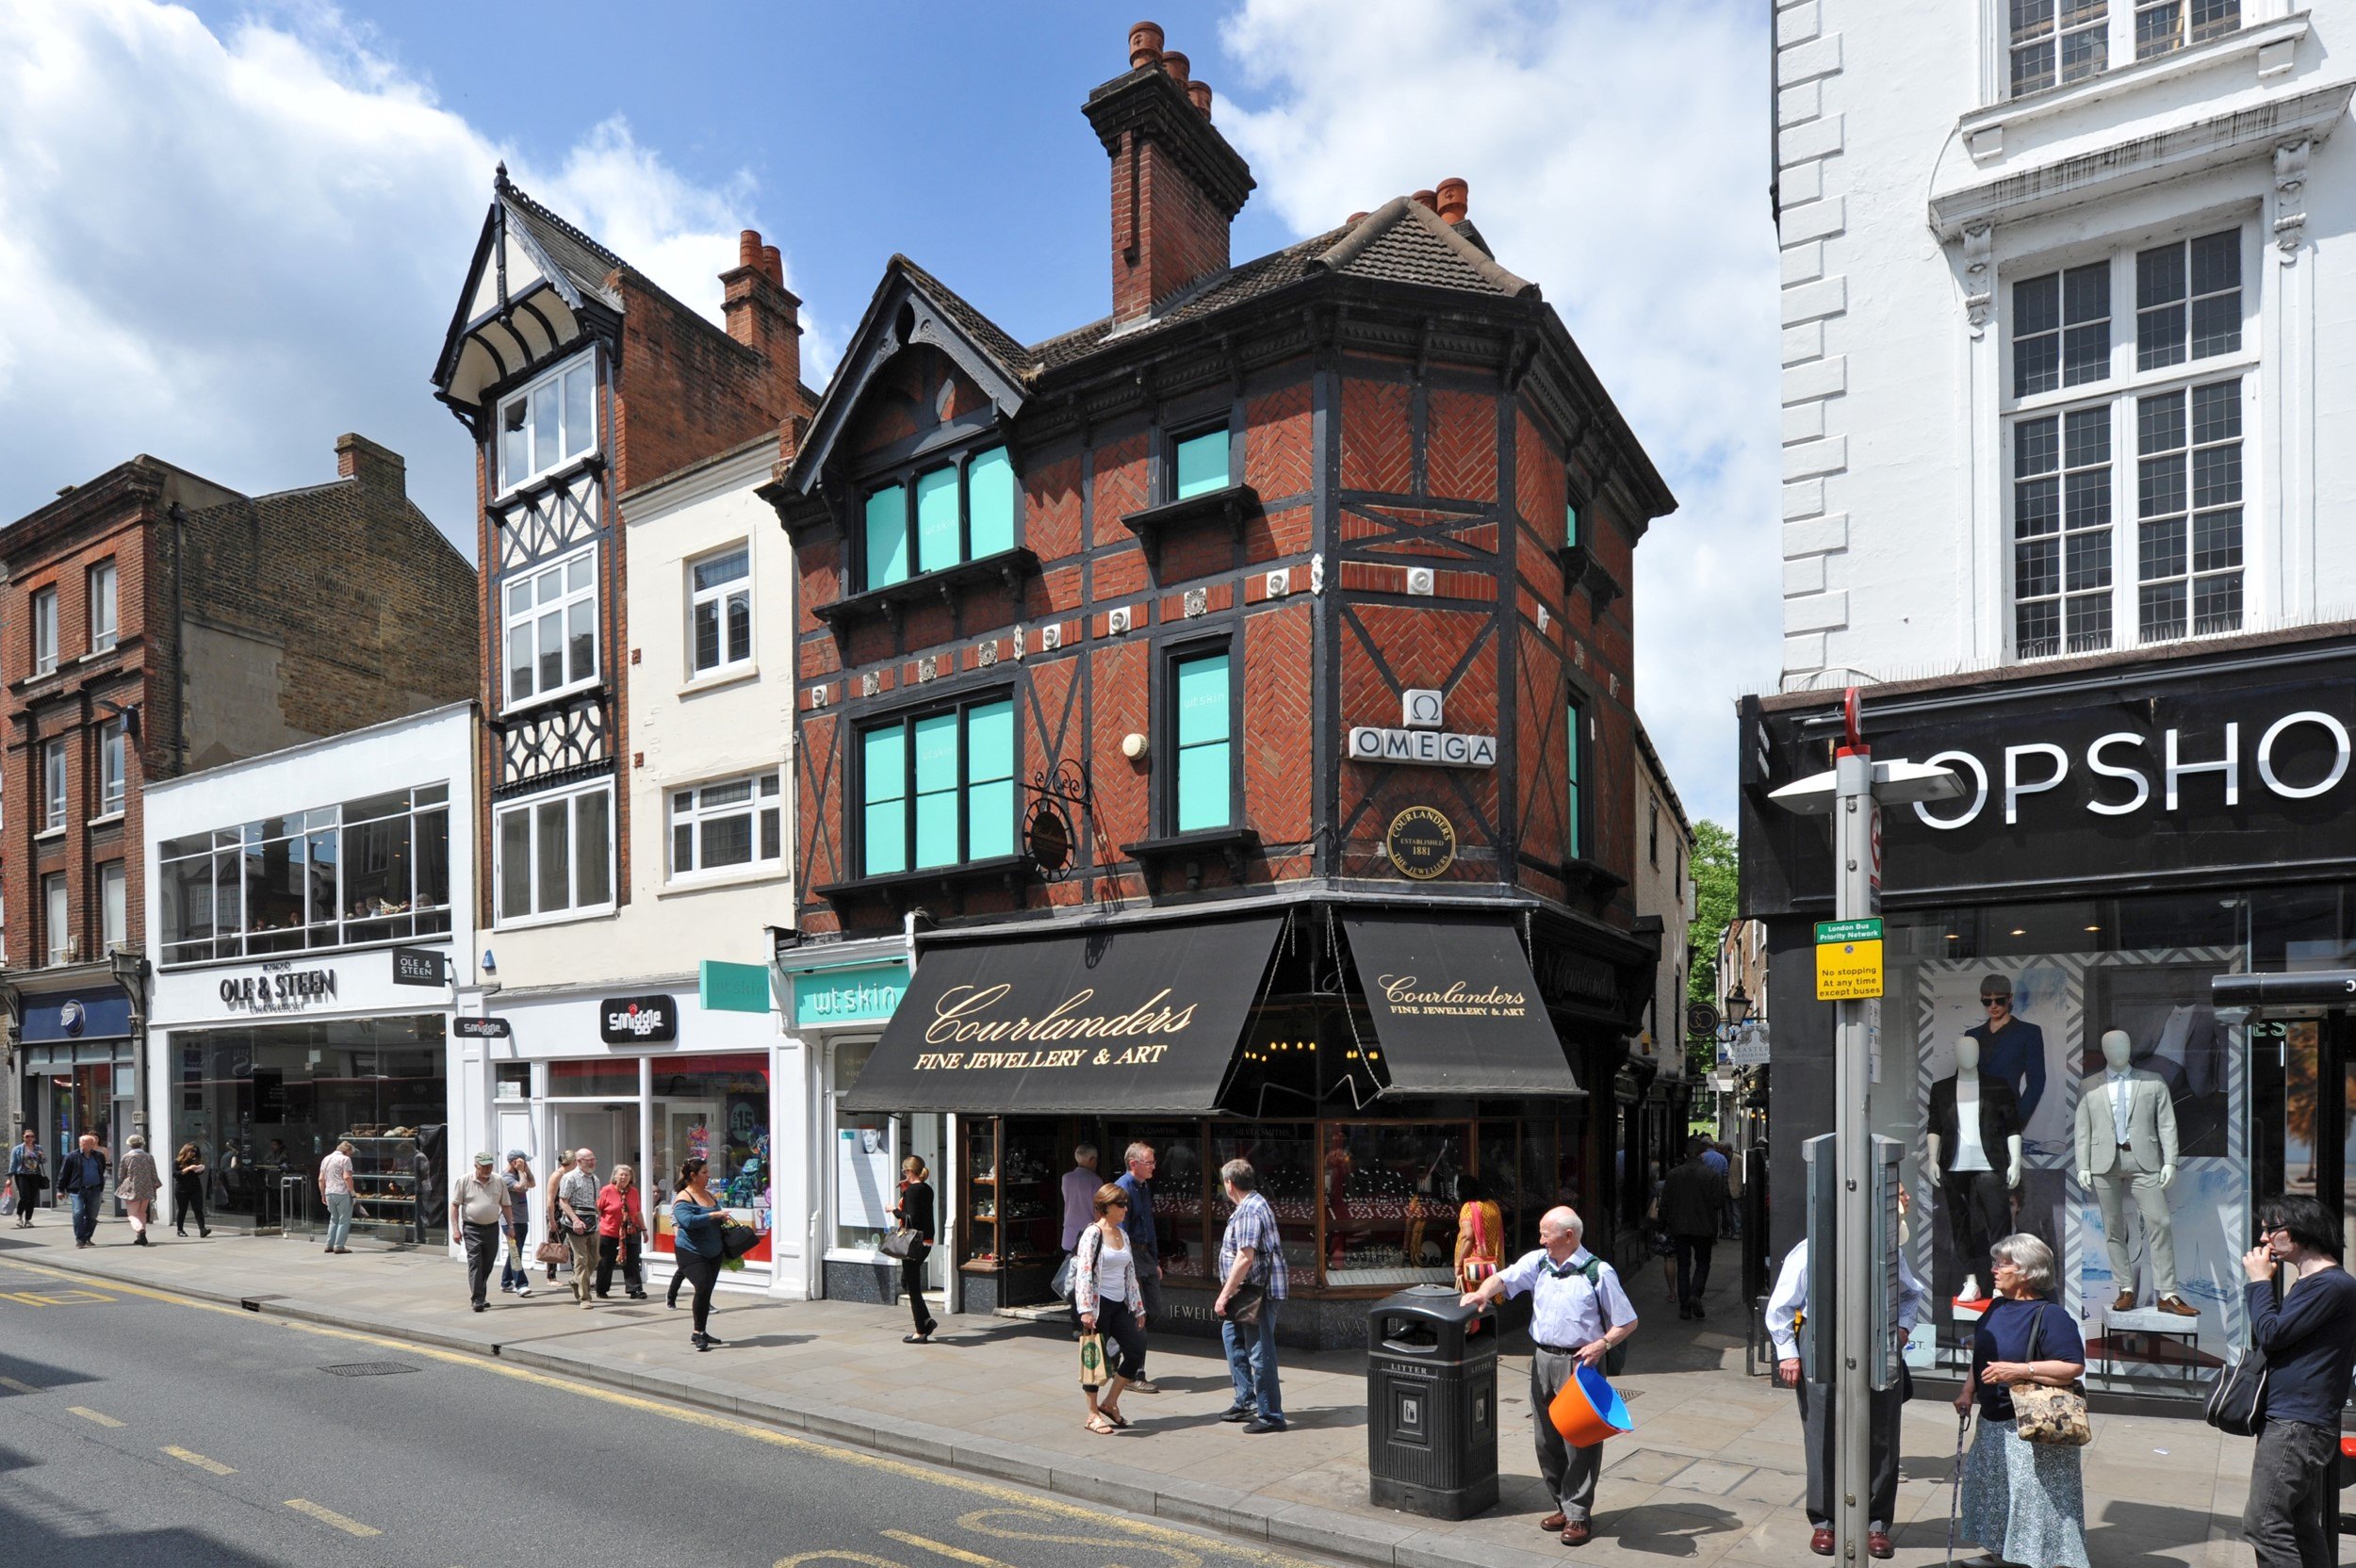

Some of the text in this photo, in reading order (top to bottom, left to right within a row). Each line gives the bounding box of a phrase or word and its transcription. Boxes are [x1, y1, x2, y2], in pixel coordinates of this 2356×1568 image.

[1358, 731, 1494, 762] OMEGA
[1871, 711, 2351, 829] OPSHO
[1393, 811, 1451, 841] COURLANDERS
[1400, 838, 1444, 846] ESTABLISHED
[1413, 846, 1431, 856] 1881
[1408, 855, 1448, 874] JEWELLERS
[1848, 930, 1879, 939] Network
[400, 957, 432, 969] OLE &
[401, 966, 433, 976] STEEN
[1838, 967, 1877, 975] stopping
[220, 969, 335, 1003] OLE & STEEN
[1378, 973, 1526, 1004] Courlanders
[1820, 988, 1850, 997] except
[925, 983, 1198, 1044] Courlanders
[1390, 1005, 1526, 1016] FINE JEWELLERY & ART
[913, 1045, 1168, 1070] FINE JEWELLERY & ART
[1170, 1304, 1223, 1322] JEWELL
[1336, 1317, 1399, 1333] WATH
[1391, 1363, 1427, 1375] LITTER
[1471, 1361, 1491, 1374] LITTER
